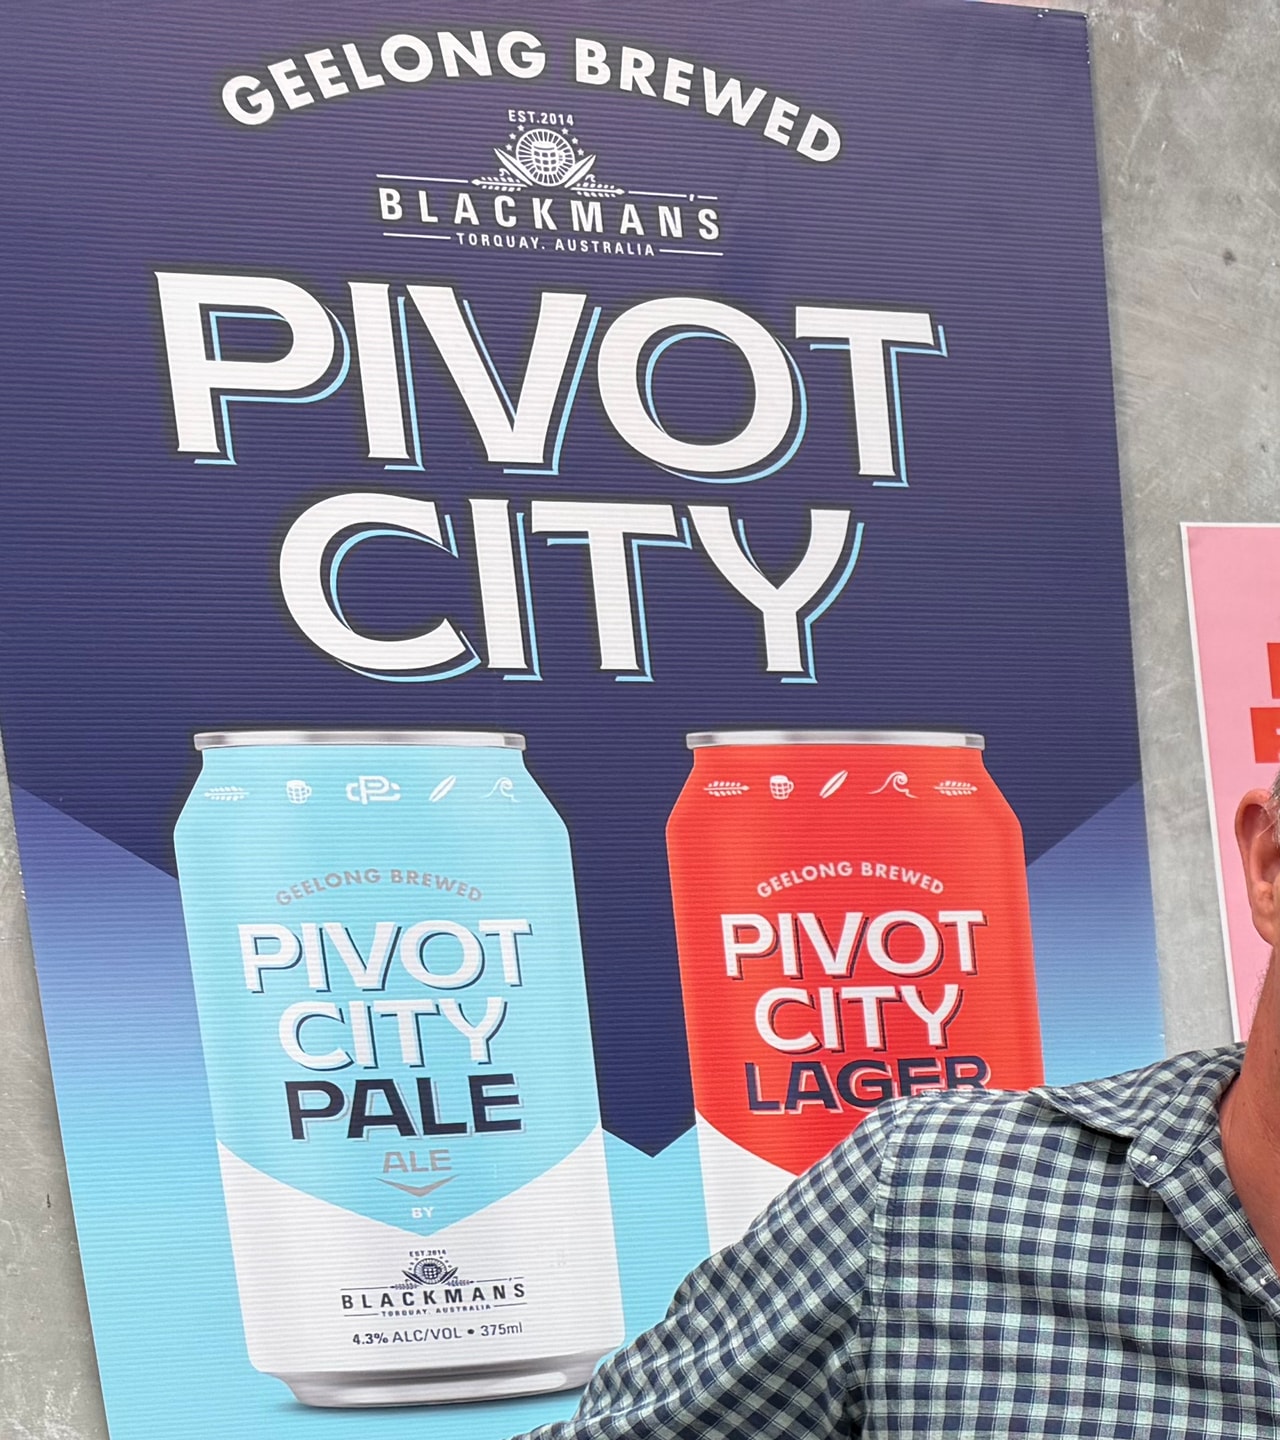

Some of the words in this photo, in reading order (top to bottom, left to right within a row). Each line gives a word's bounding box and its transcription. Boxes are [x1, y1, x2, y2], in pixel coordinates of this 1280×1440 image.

[222, 30, 546, 126] GEELONG
[574, 36, 842, 163] BREWED
[508, 109, 574, 127] EST.2014
[554, 239, 656, 257] AUSTRALIA
[155, 271, 947, 487] PIVOT
[279, 492, 864, 683] CITY
[275, 868, 382, 906] GEELONG
[390, 868, 483, 902] BREWED
[756, 860, 853, 898] GEELONG
[860, 861, 944, 895] BREWED
[237, 918, 534, 994] PIVOT
[720, 910, 988, 980] PIVOT
[278, 996, 508, 1072] CITY
[754, 983, 964, 1053] CITY
[284, 1072, 527, 1142] PALE
[744, 1055, 992, 1115] LAGER
[382, 1149, 453, 1174] ALE
[411, 1207, 434, 1219] BY
[352, 1332, 389, 1346] 4.3%
[392, 1327, 462, 1344] ALC/VOL
[480, 1322, 523, 1337] 375ml
[436, 1303, 491, 1314] AUSTRALIA
